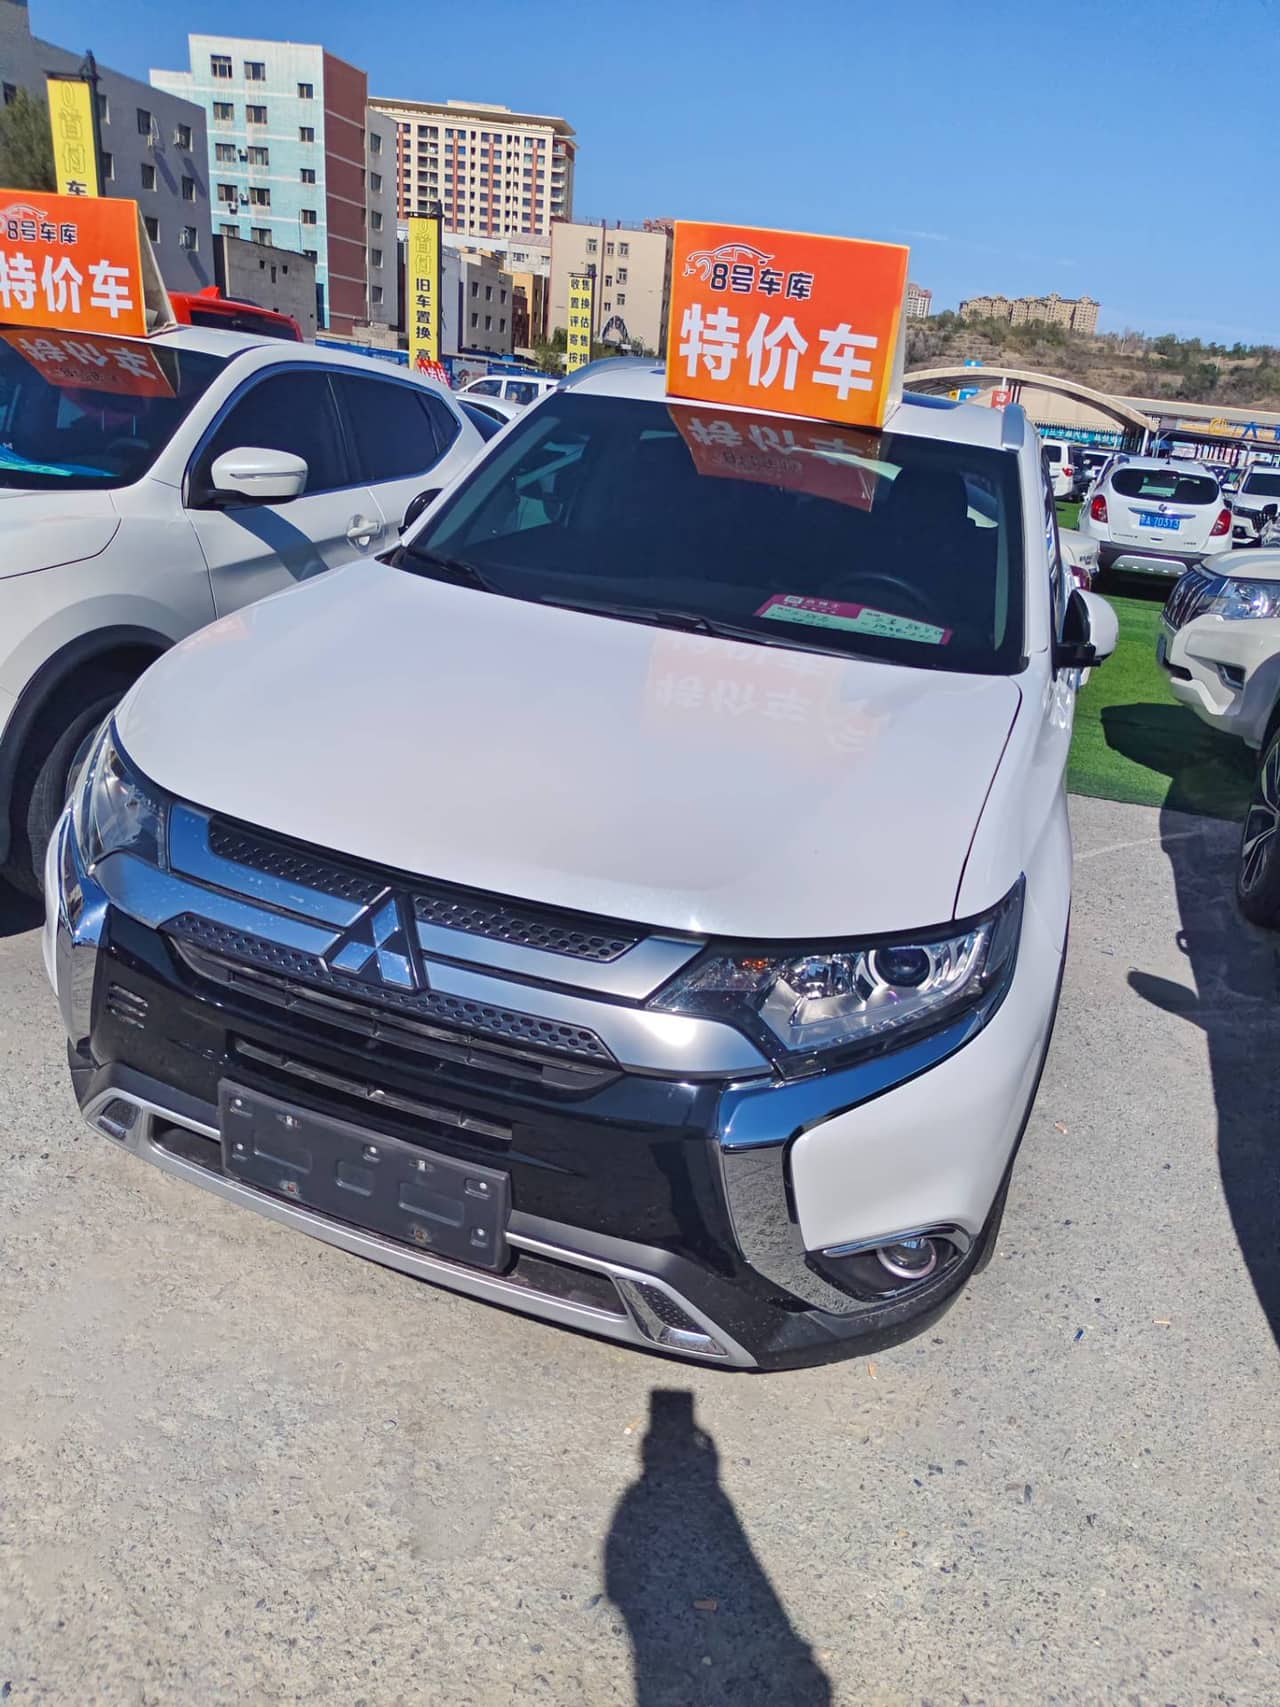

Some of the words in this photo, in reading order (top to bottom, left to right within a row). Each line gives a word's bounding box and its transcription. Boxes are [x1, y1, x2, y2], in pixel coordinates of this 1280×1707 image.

[7, 219, 79, 244] 8号车库
[0, 252, 133, 318] 特价车
[415, 277, 432, 340] 旧车置换
[709, 262, 813, 299] 8号车库
[679, 303, 879, 400] 特价车
